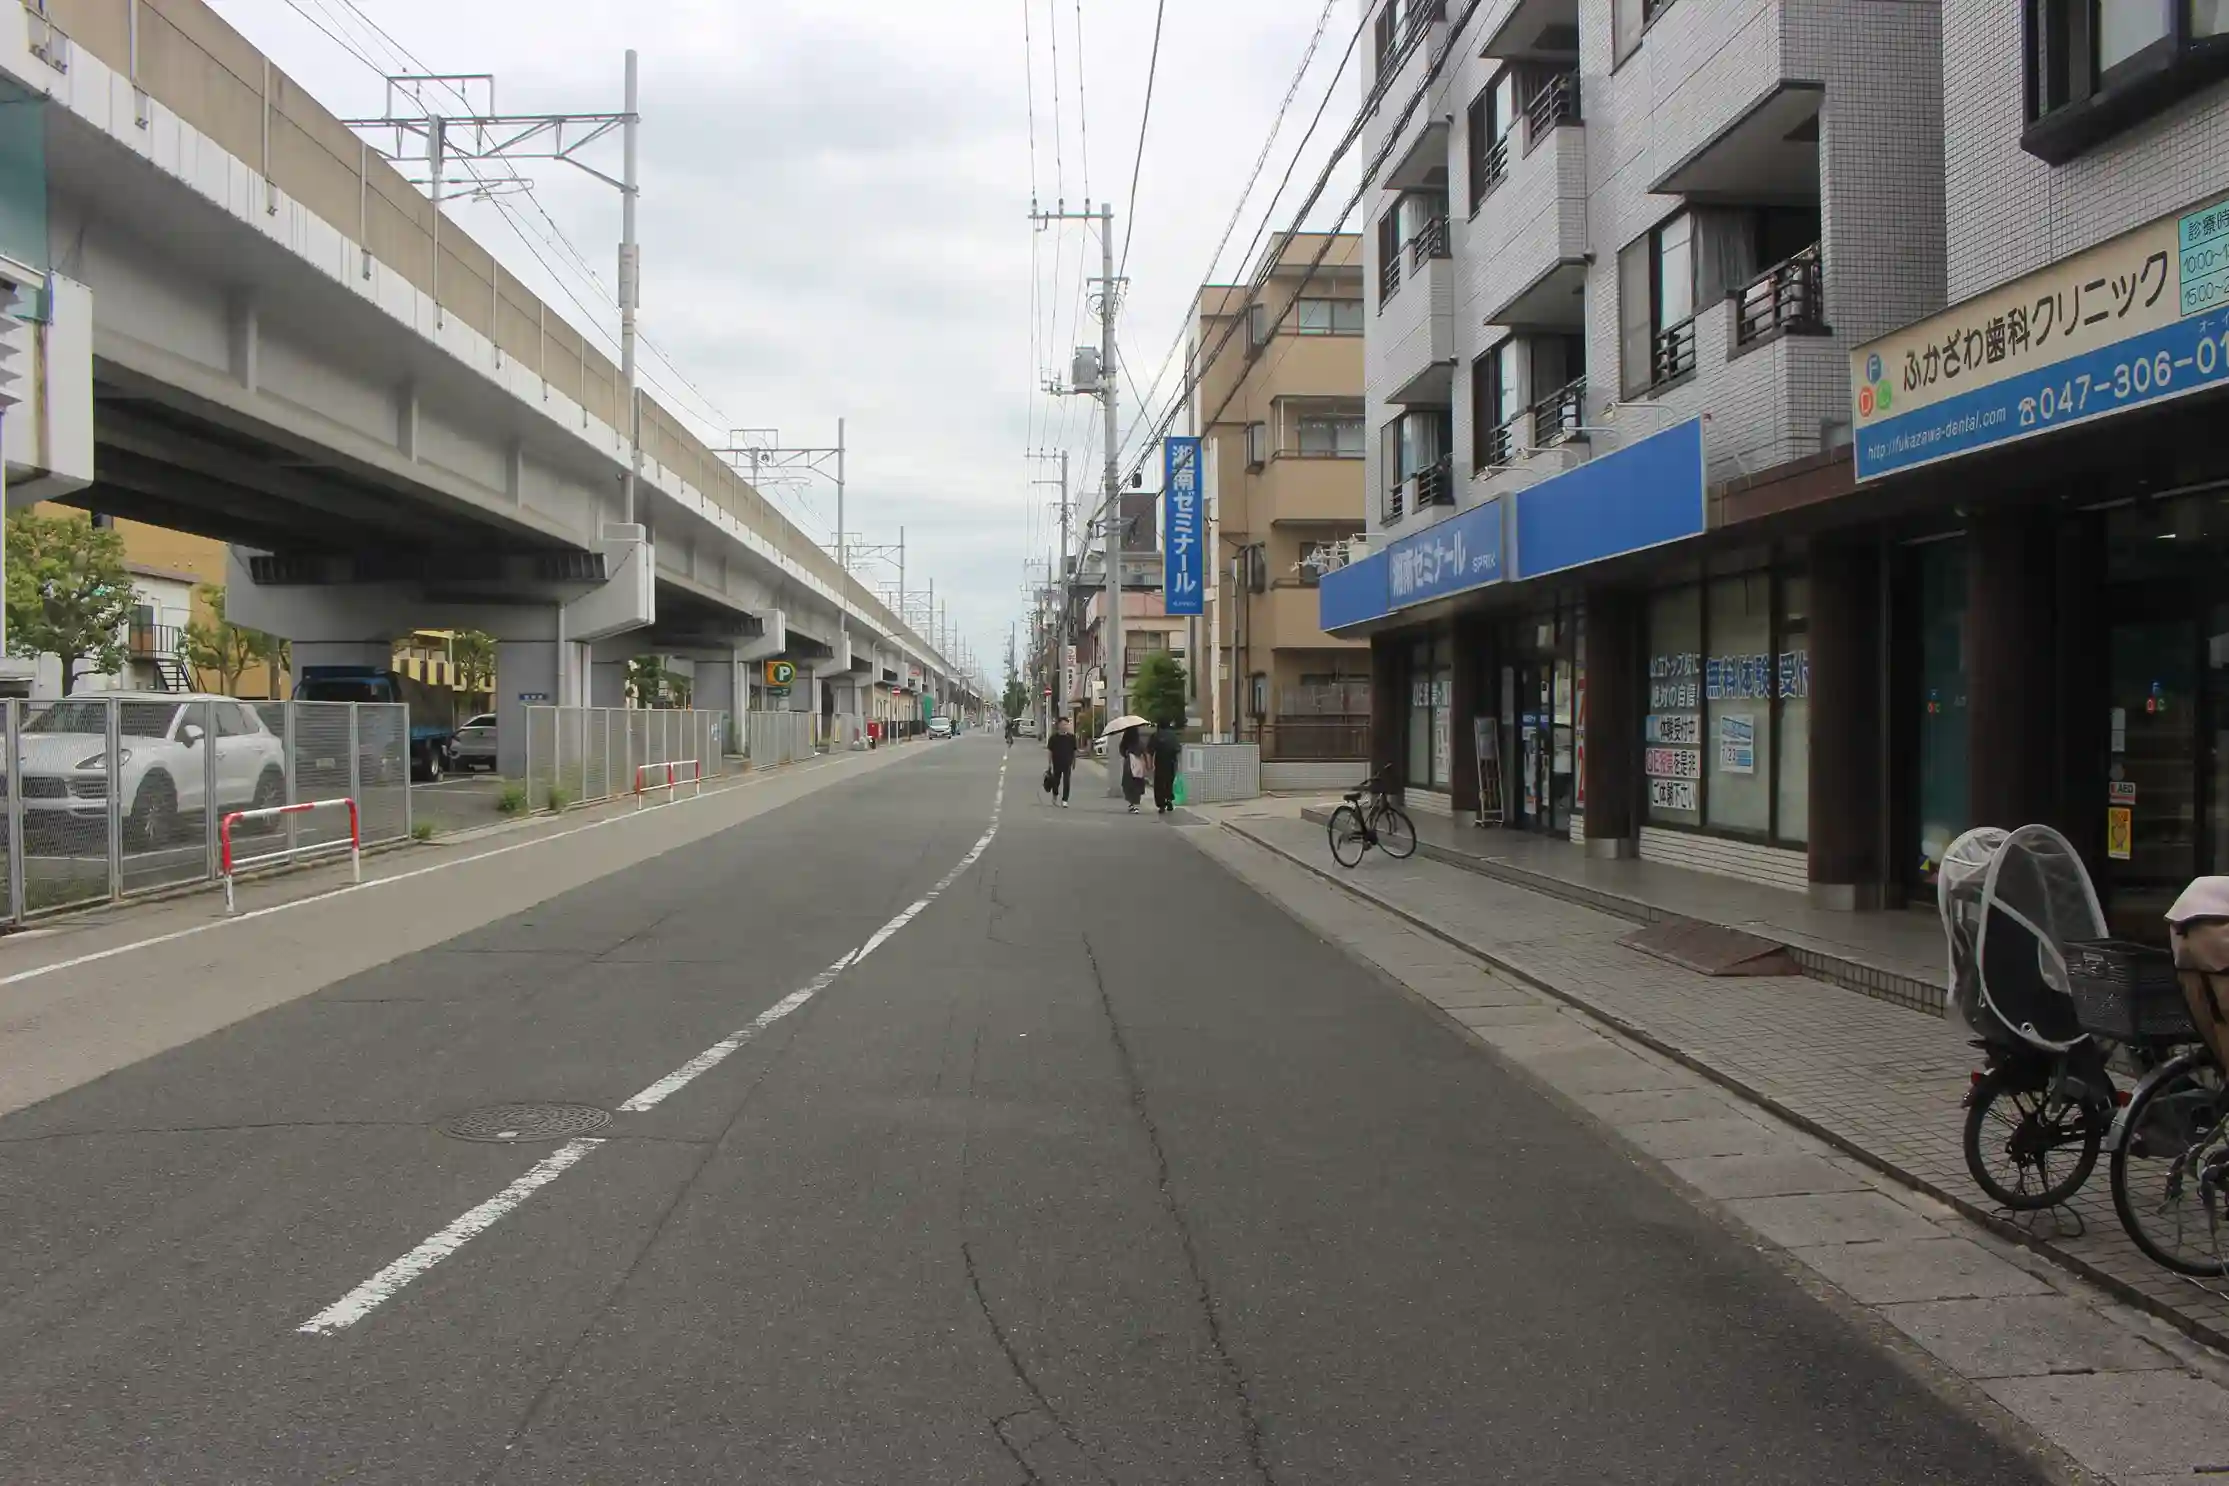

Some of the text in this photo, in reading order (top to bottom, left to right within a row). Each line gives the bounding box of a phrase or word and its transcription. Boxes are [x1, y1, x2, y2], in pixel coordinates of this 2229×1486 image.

[1903, 251, 2168, 392] ふかざわ歯科クリニック
[2039, 331, 2229, 420] 047-306-01
[1868, 406, 2007, 461] http://fukazawa-dental.com
[1171, 444, 1197, 595] 湘南ゼミナール
[1392, 529, 1466, 598] 湘南ゼミナール
[2117, 783, 2134, 794] AED
